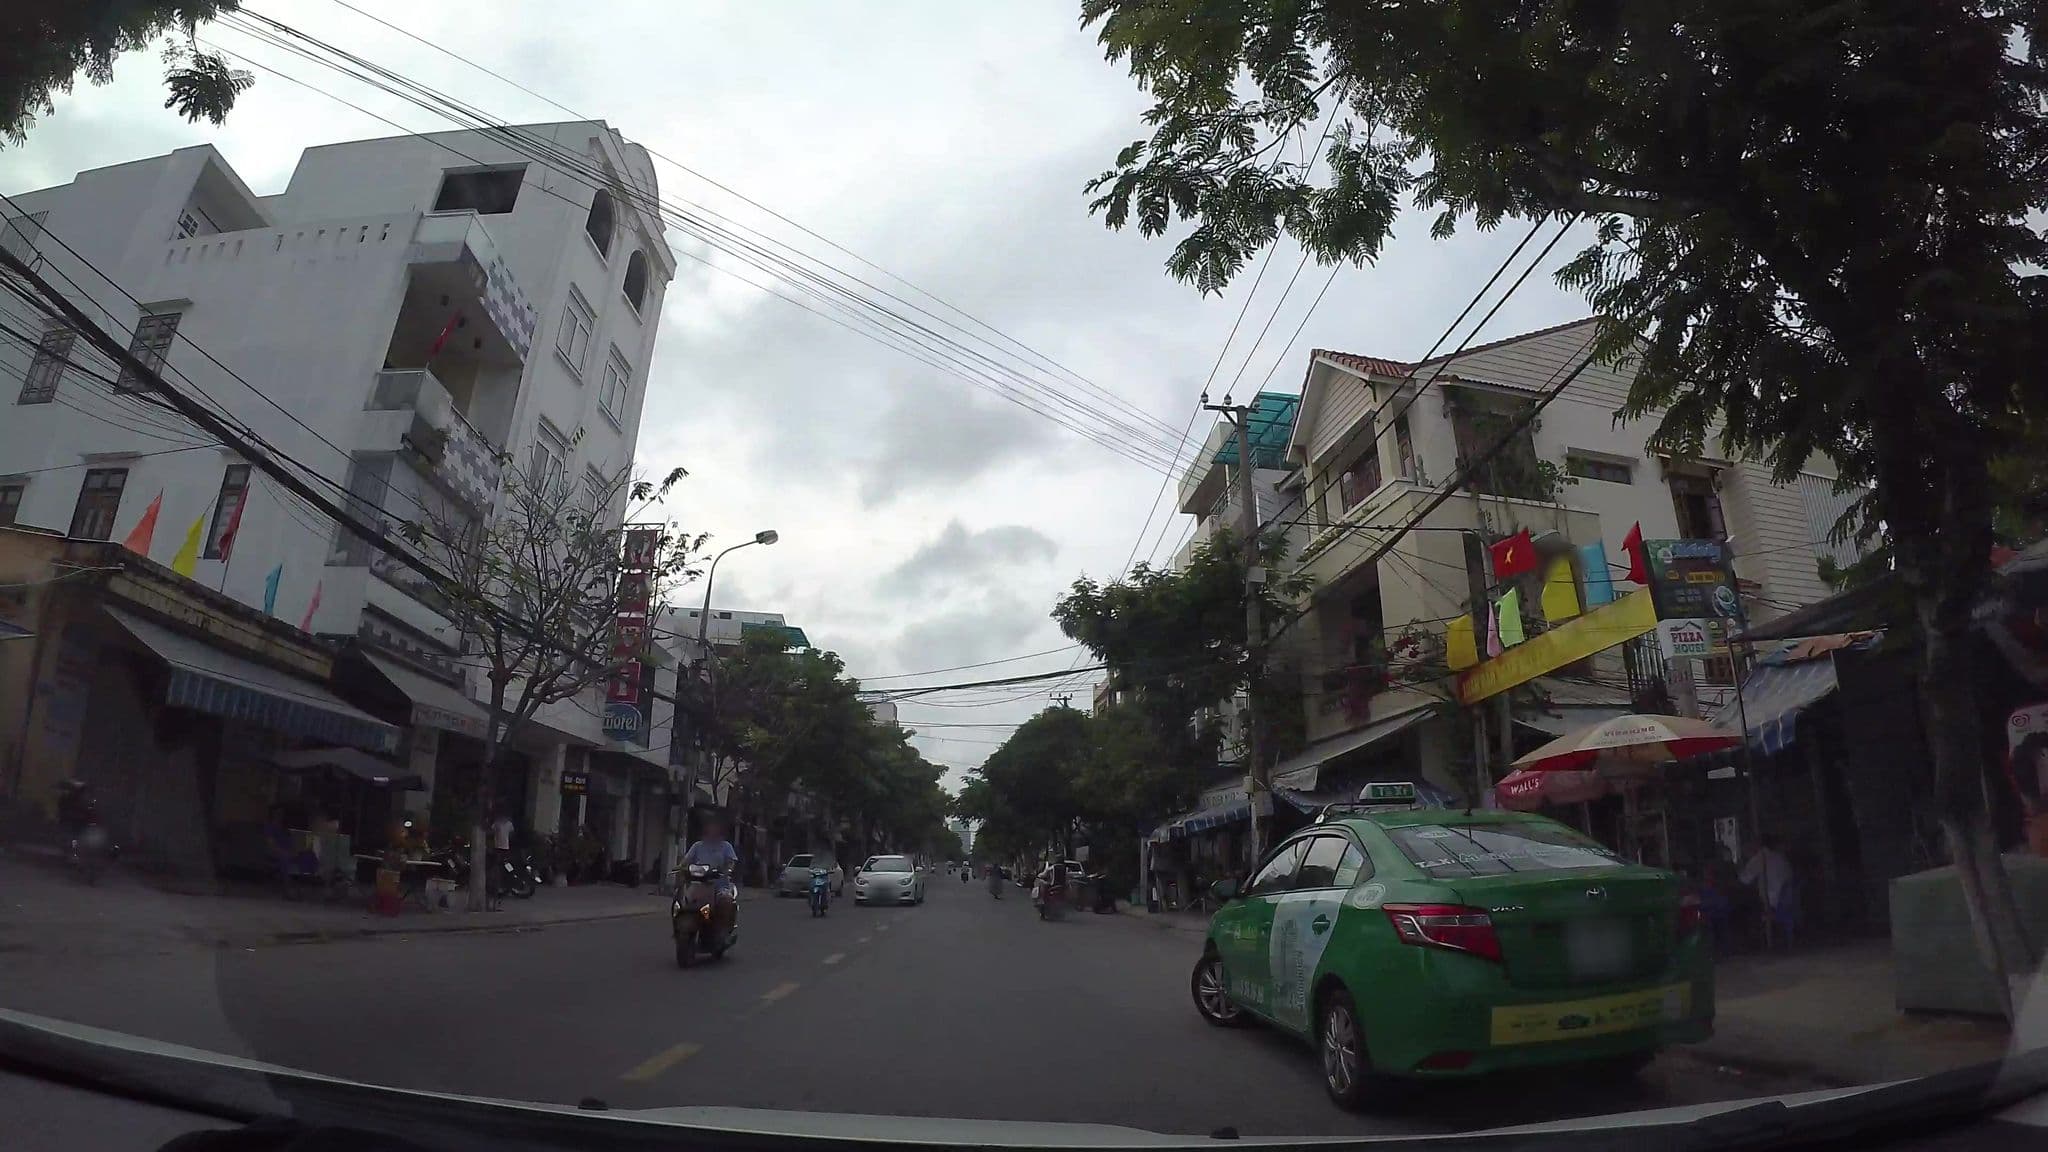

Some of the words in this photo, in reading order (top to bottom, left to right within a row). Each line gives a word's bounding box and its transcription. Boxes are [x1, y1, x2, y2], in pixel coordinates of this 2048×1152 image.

[1670, 631, 1705, 643] PIZZA
[1674, 643, 1706, 653] HOUSE
[1375, 786, 1409, 797] TAXI
[1510, 778, 1540, 796] WALL'S
